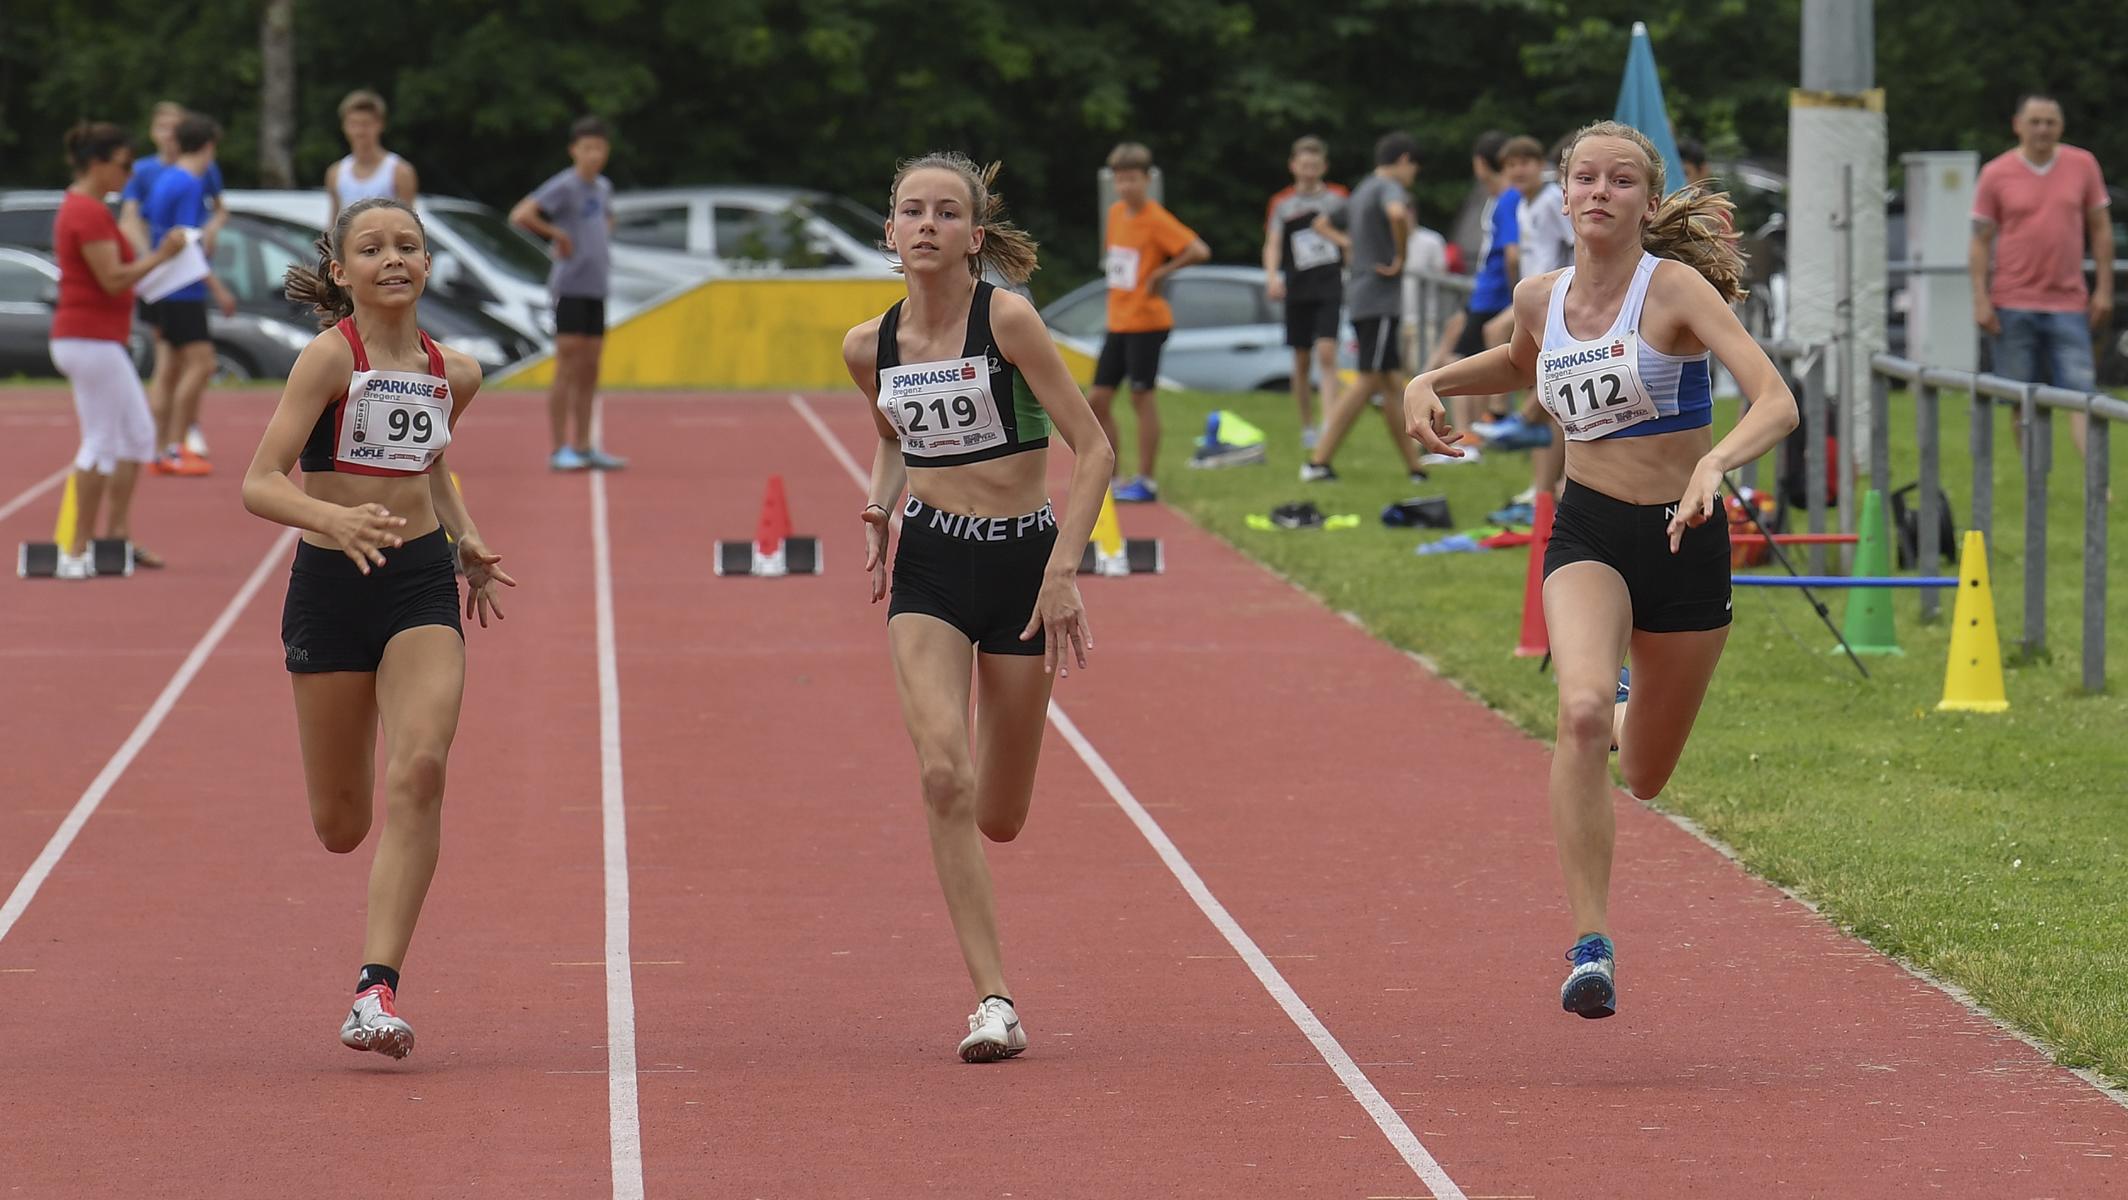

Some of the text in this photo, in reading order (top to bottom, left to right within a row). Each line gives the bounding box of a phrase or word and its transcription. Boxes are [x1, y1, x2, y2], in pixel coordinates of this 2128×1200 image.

[1544, 347, 1609, 373] SPARKASSE
[366, 380, 434, 398] SPARKASSE
[892, 369, 960, 388] SPARKASSE
[364, 391, 401, 401] Bregenz
[892, 387, 922, 397] Bregenz
[1558, 373, 1628, 416] 112
[356, 402, 364, 430] MADER
[388, 409, 433, 444] 99
[904, 396, 977, 432] 219
[350, 446, 385, 458] HÖFLE
[929, 509, 1008, 541] NIKE
